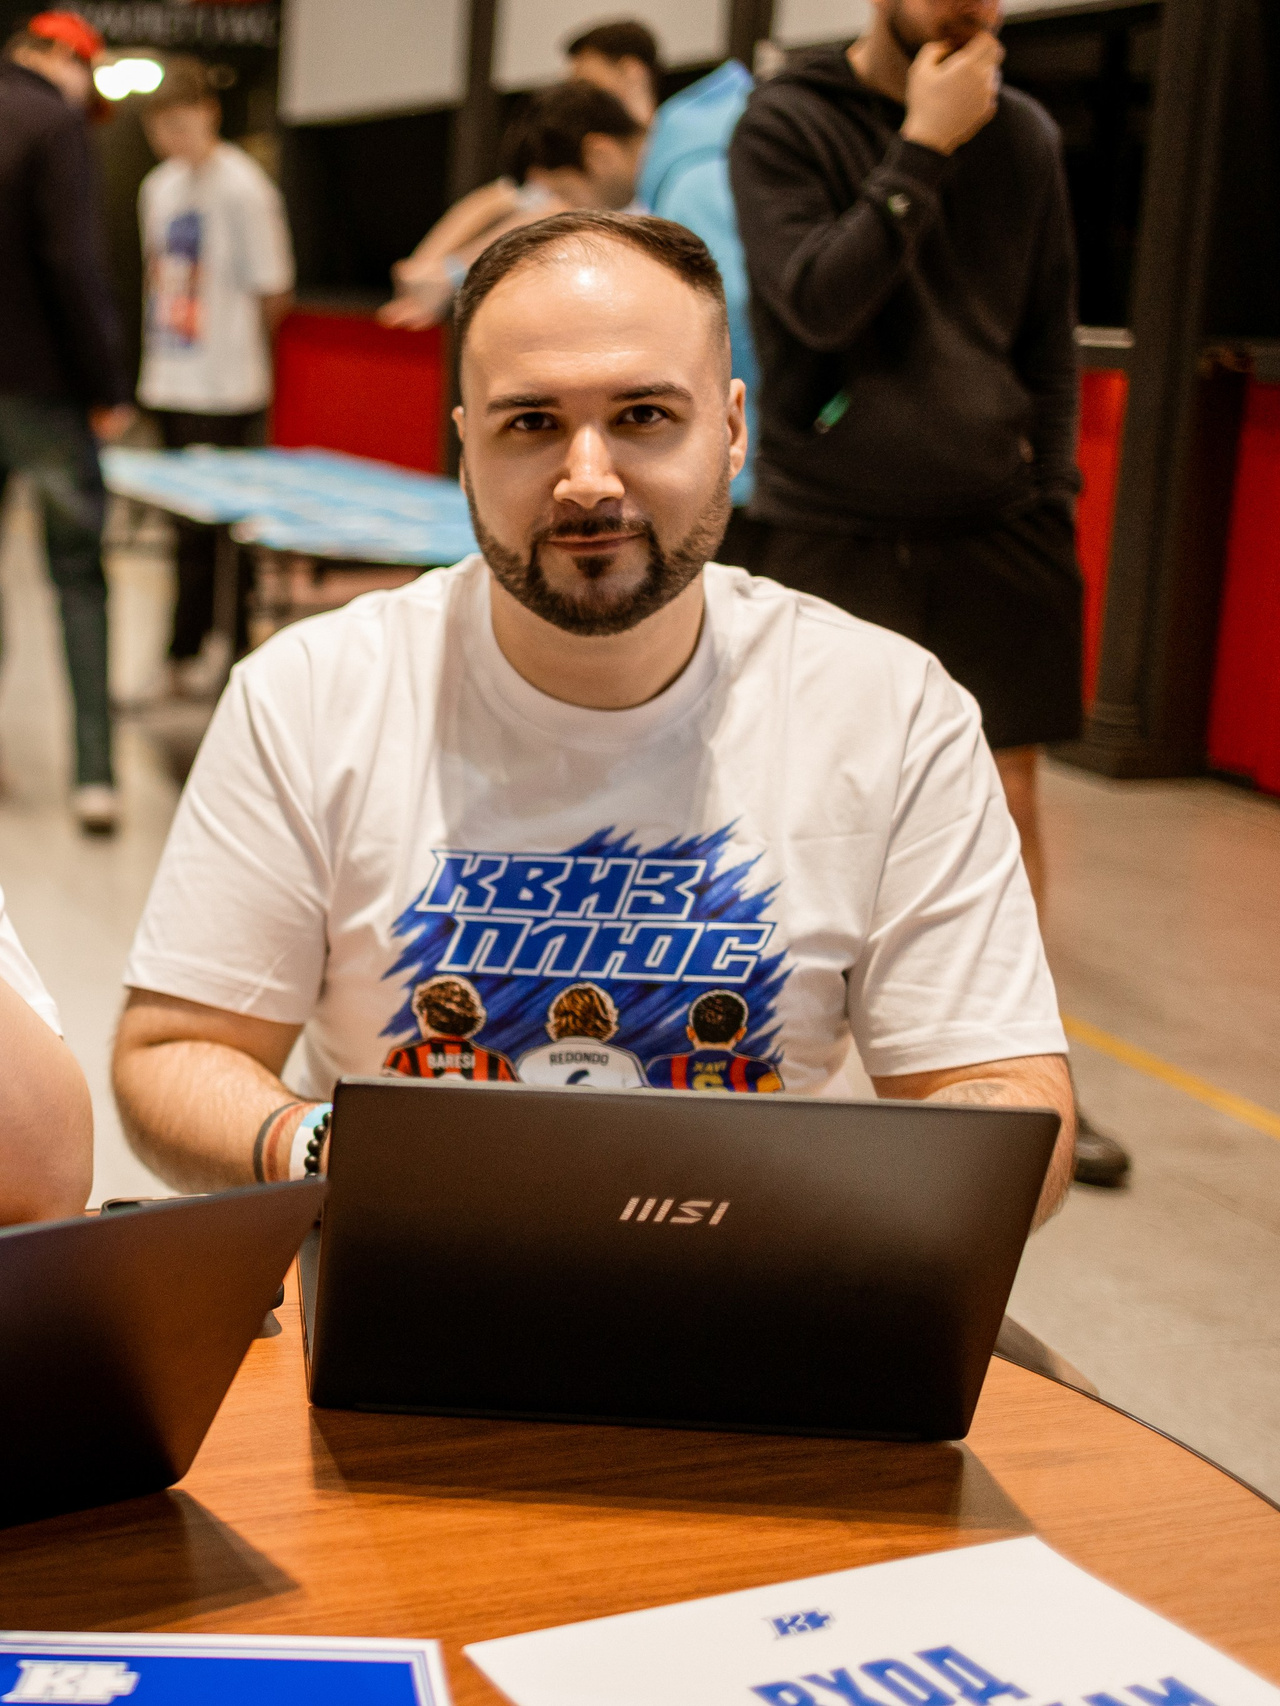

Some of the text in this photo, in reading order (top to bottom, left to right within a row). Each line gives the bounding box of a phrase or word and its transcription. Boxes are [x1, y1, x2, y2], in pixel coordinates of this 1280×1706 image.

[415, 852, 707, 921] КВИЗ
[436, 914, 776, 984] ПЛЮС
[427, 1053, 476, 1069] BARESI
[549, 1052, 609, 1066] REDONDO
